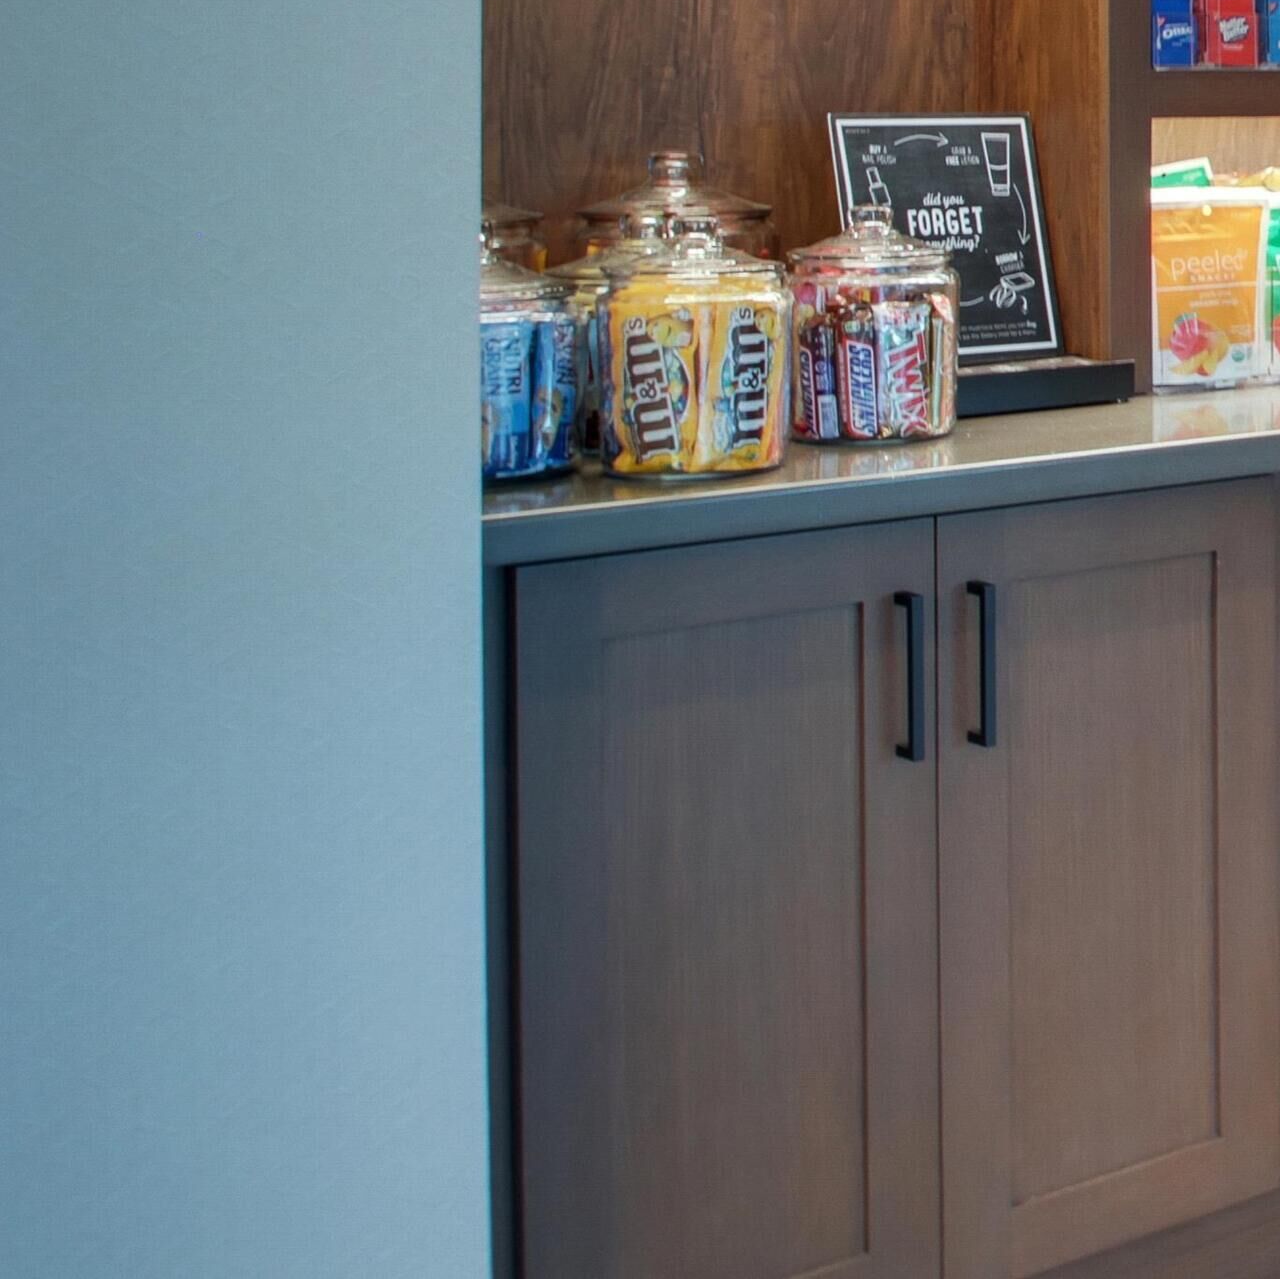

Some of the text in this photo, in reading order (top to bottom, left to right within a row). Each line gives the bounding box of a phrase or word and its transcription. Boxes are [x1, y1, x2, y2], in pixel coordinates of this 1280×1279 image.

[923, 193, 965, 209] did you
[906, 206, 983, 237] FORGET
[1170, 248, 1244, 281] peeled
[849, 342, 876, 437] SNICKERS
[888, 330, 930, 438] TWIX
